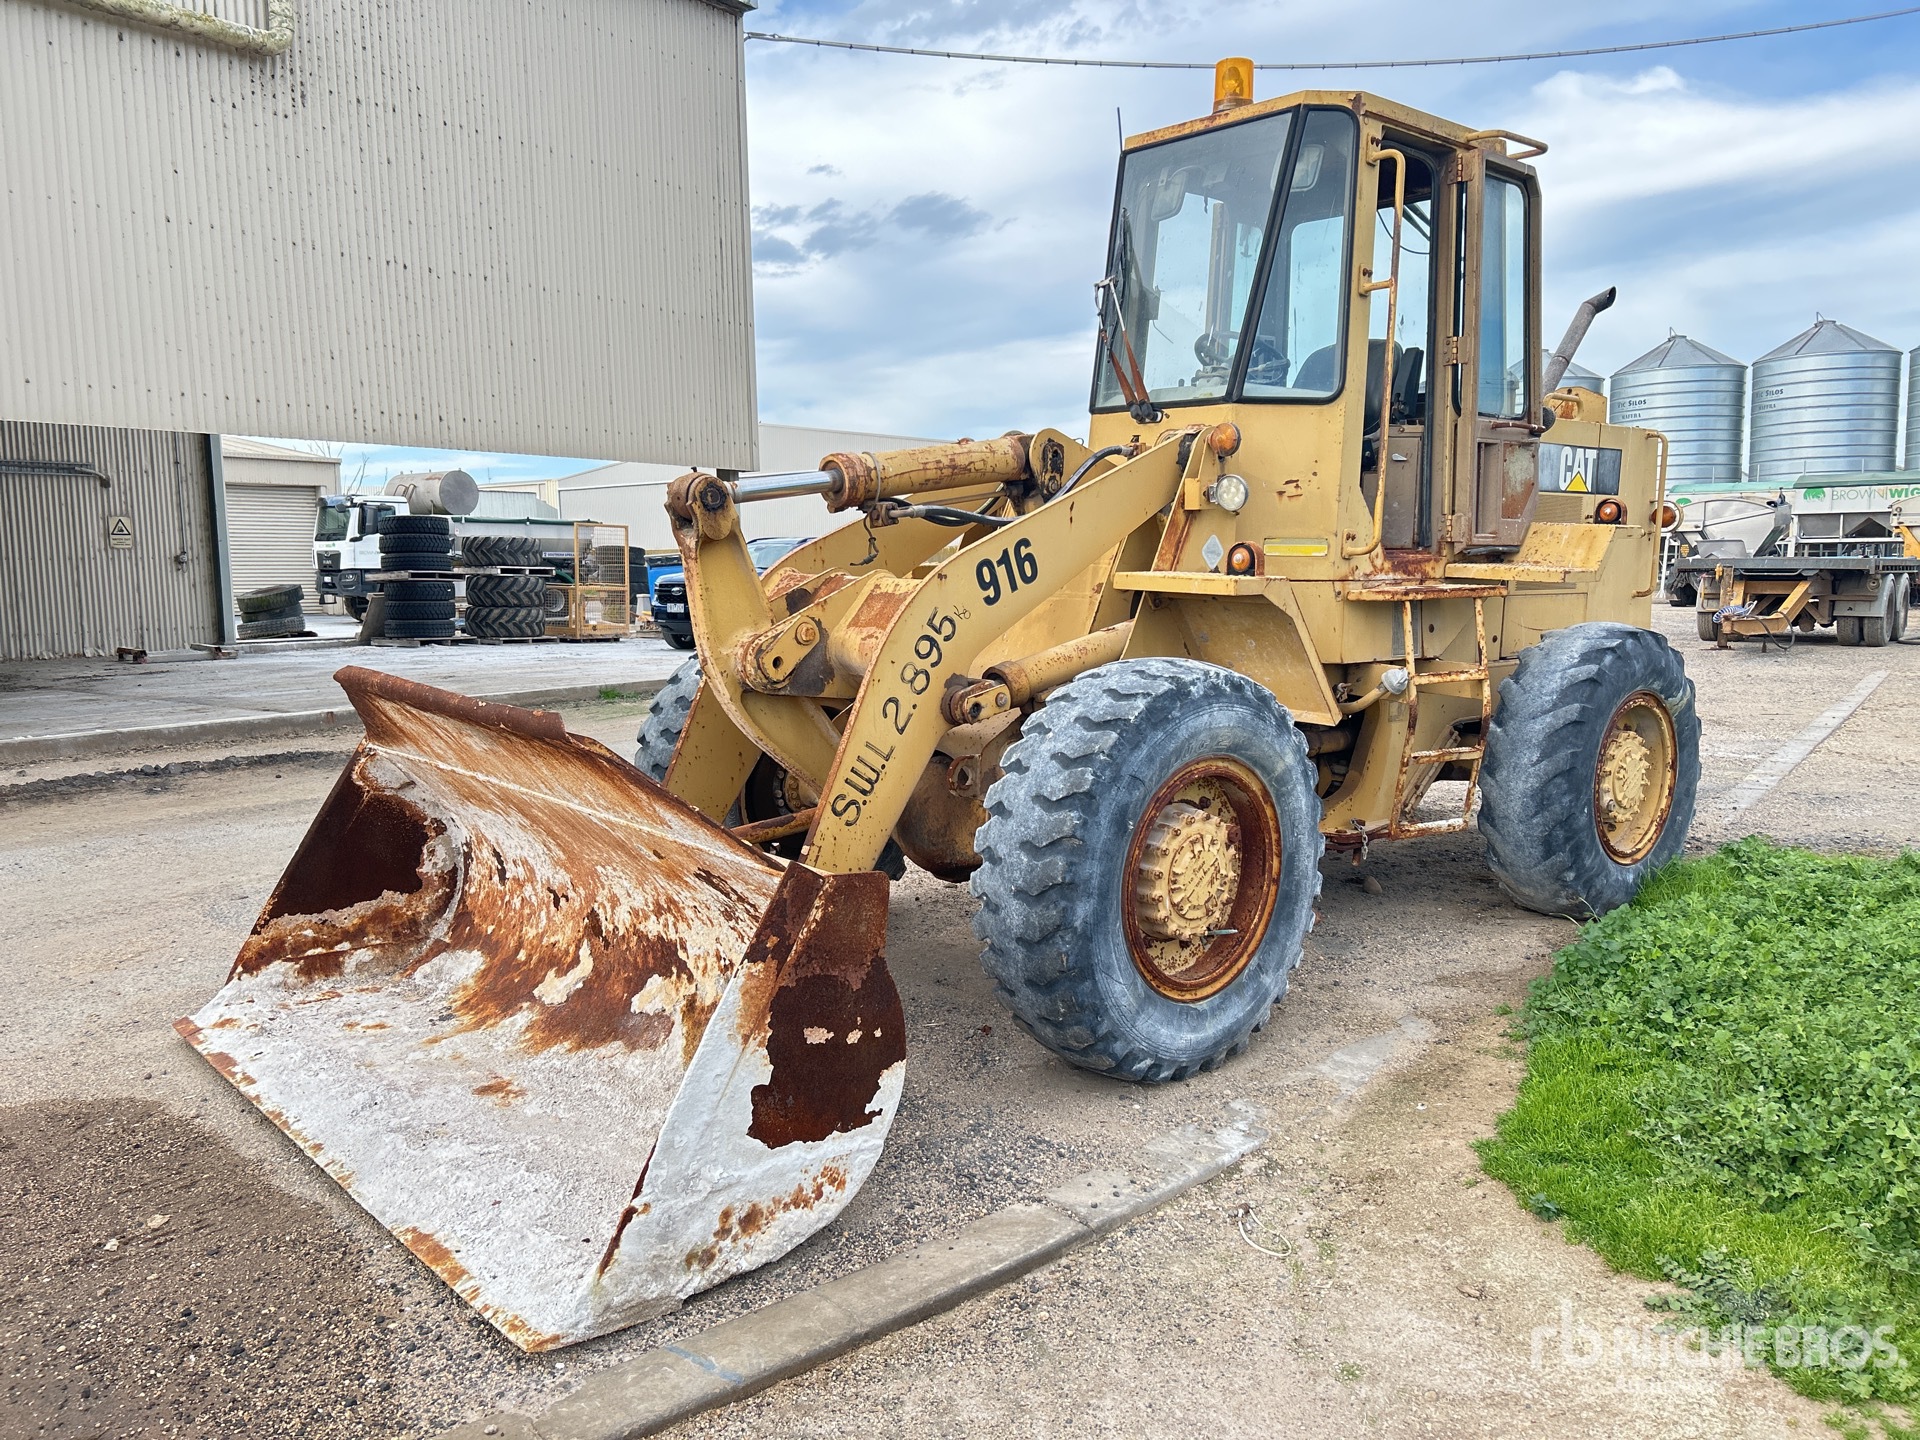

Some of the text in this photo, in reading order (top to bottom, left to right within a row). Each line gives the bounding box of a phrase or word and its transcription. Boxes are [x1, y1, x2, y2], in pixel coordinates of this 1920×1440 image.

[1559, 446, 1597, 493] CAT
[975, 537, 1039, 606] 916
[883, 606, 957, 735] 2.895
